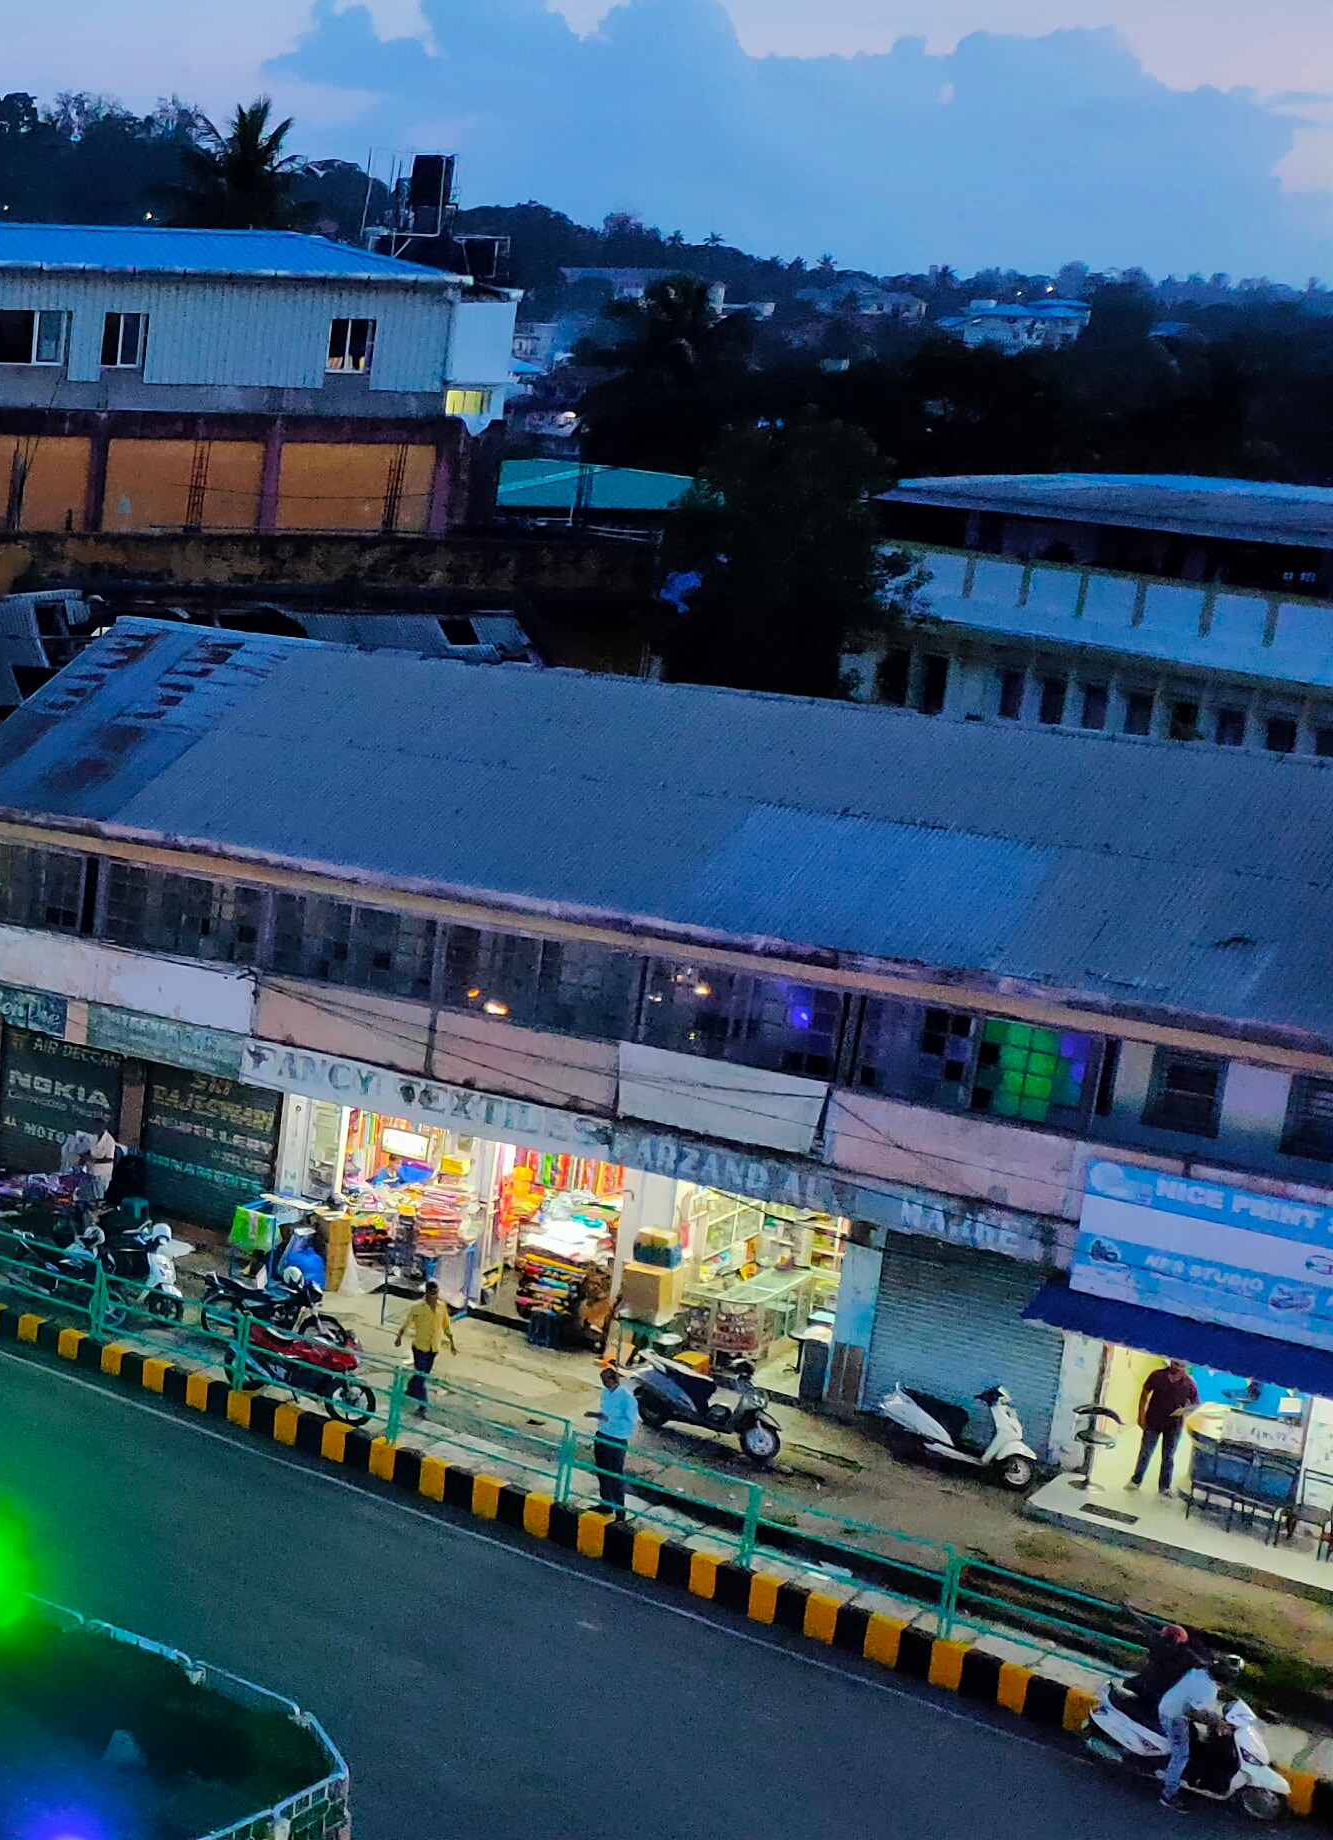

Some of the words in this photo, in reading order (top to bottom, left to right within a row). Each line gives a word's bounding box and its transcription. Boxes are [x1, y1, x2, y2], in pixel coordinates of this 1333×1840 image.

[33, 1037, 60, 1055] AIR
[8, 1069, 112, 1109] NOKIA
[247, 1045, 377, 1097] FANCY
[1155, 1178, 1225, 1210] NICE
[1231, 1194, 1323, 1229] PRINT
[1188, 1264, 1265, 1292] STUDIO
